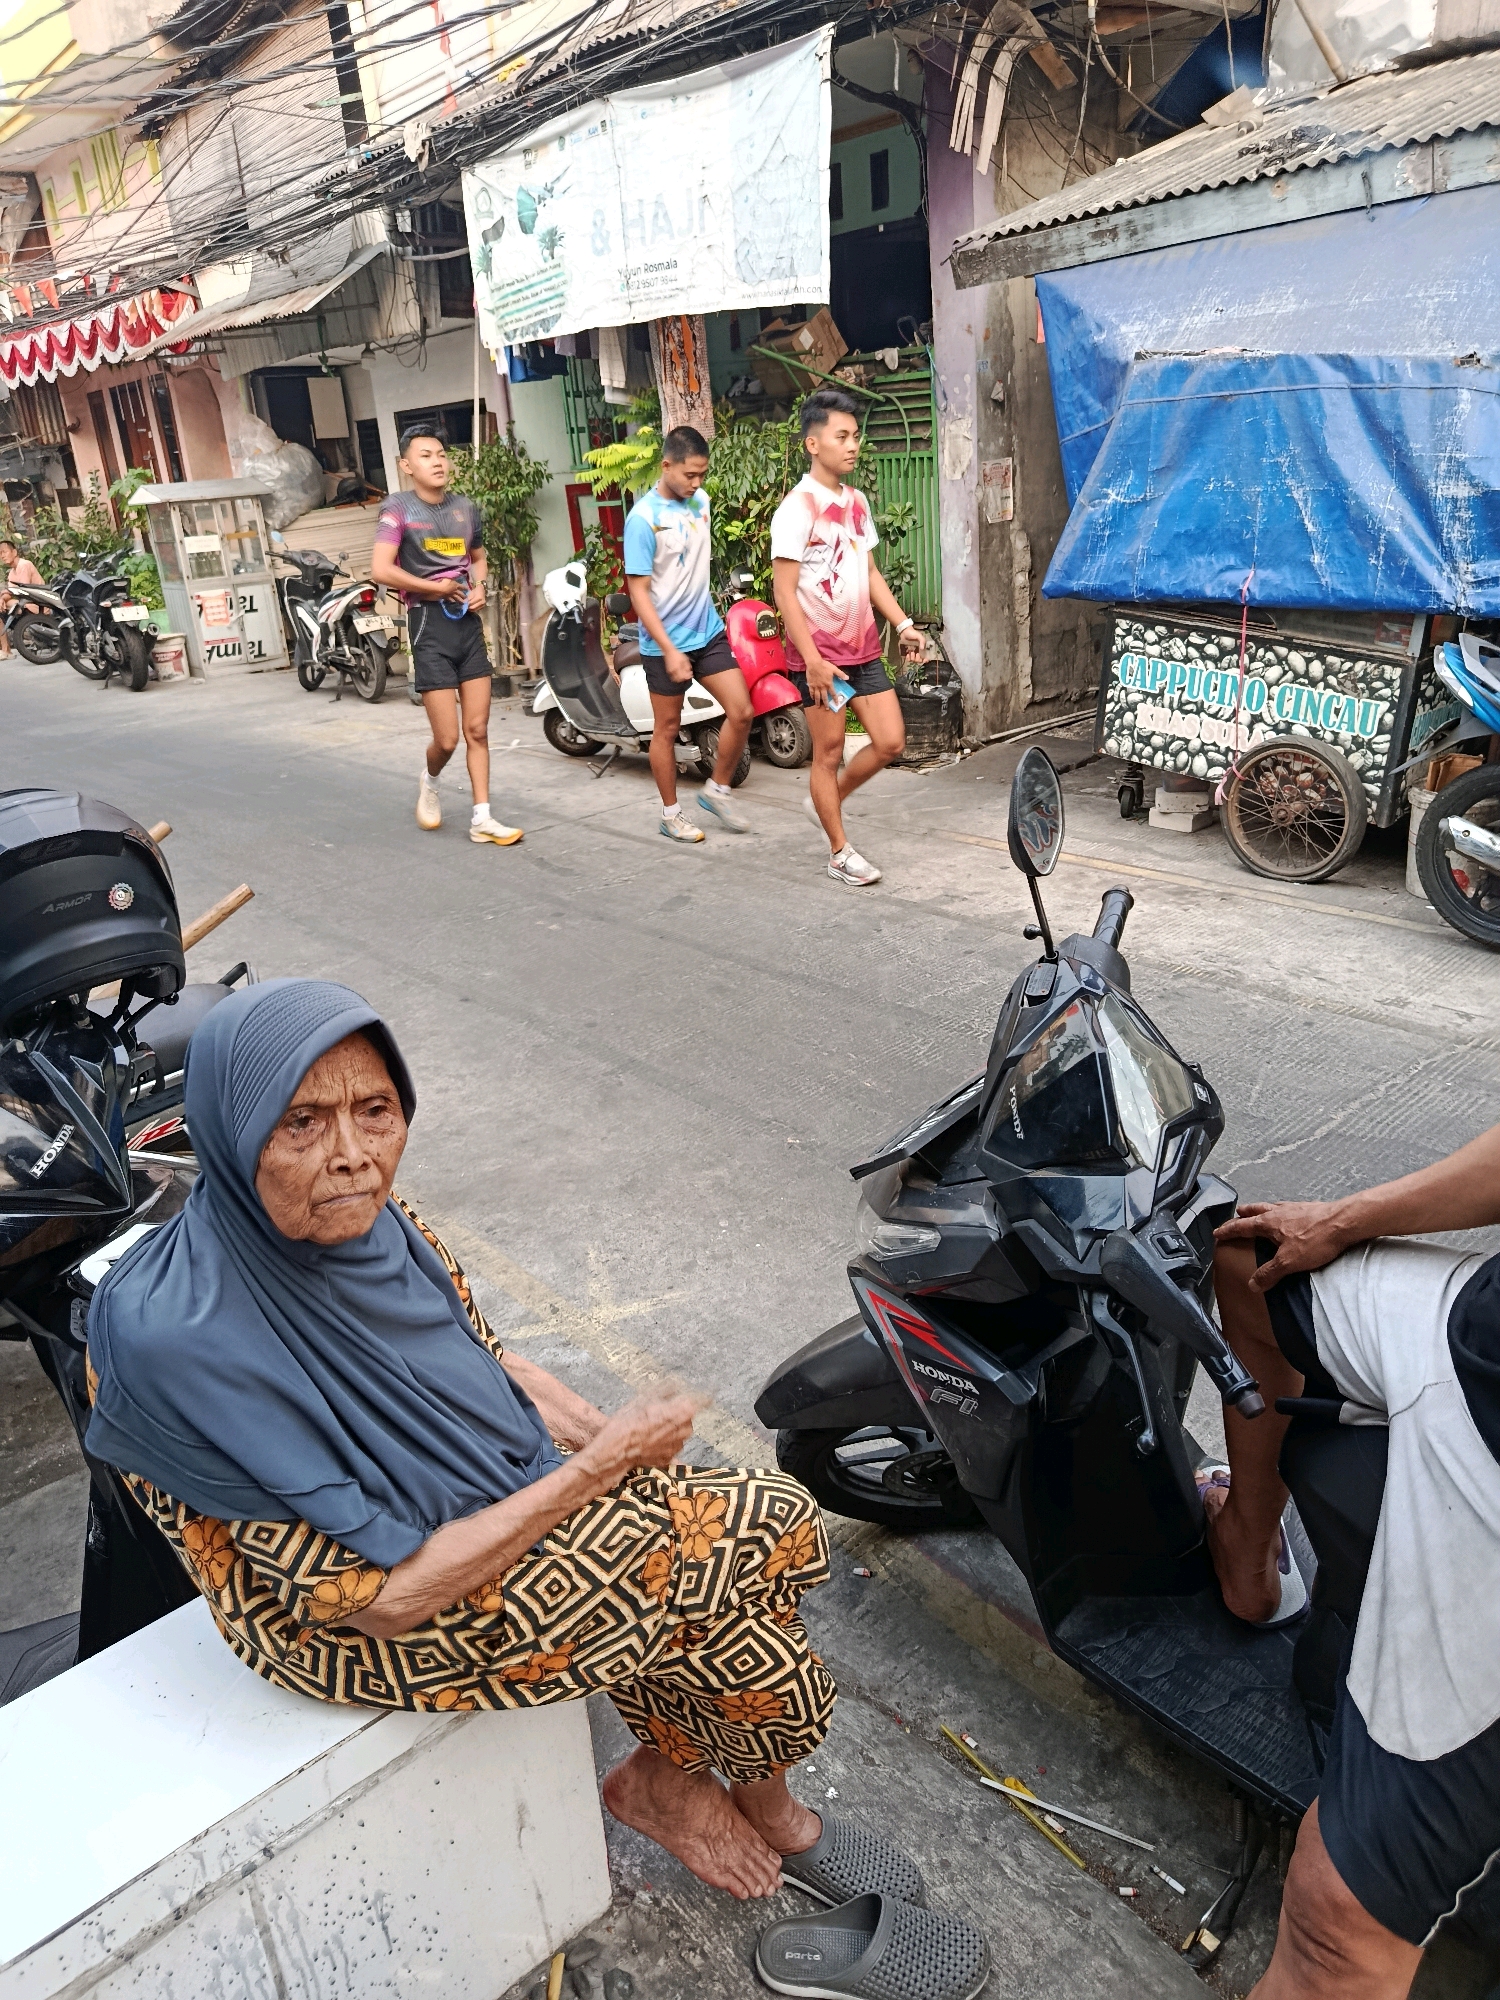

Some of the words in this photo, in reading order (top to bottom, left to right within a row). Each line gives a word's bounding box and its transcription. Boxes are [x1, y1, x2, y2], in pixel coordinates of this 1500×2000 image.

[591, 208, 612, 257] &
[643, 258, 678, 273] Rosmala
[1118, 653, 1267, 713] CAPPUCINO
[1275, 684, 1381, 737] CINCAU
[1138, 706, 1199, 738] KHAS
[42, 893, 93, 915] ARMOR
[30, 1123, 75, 1178] HONDA
[911, 1359, 981, 1396] HONDA
